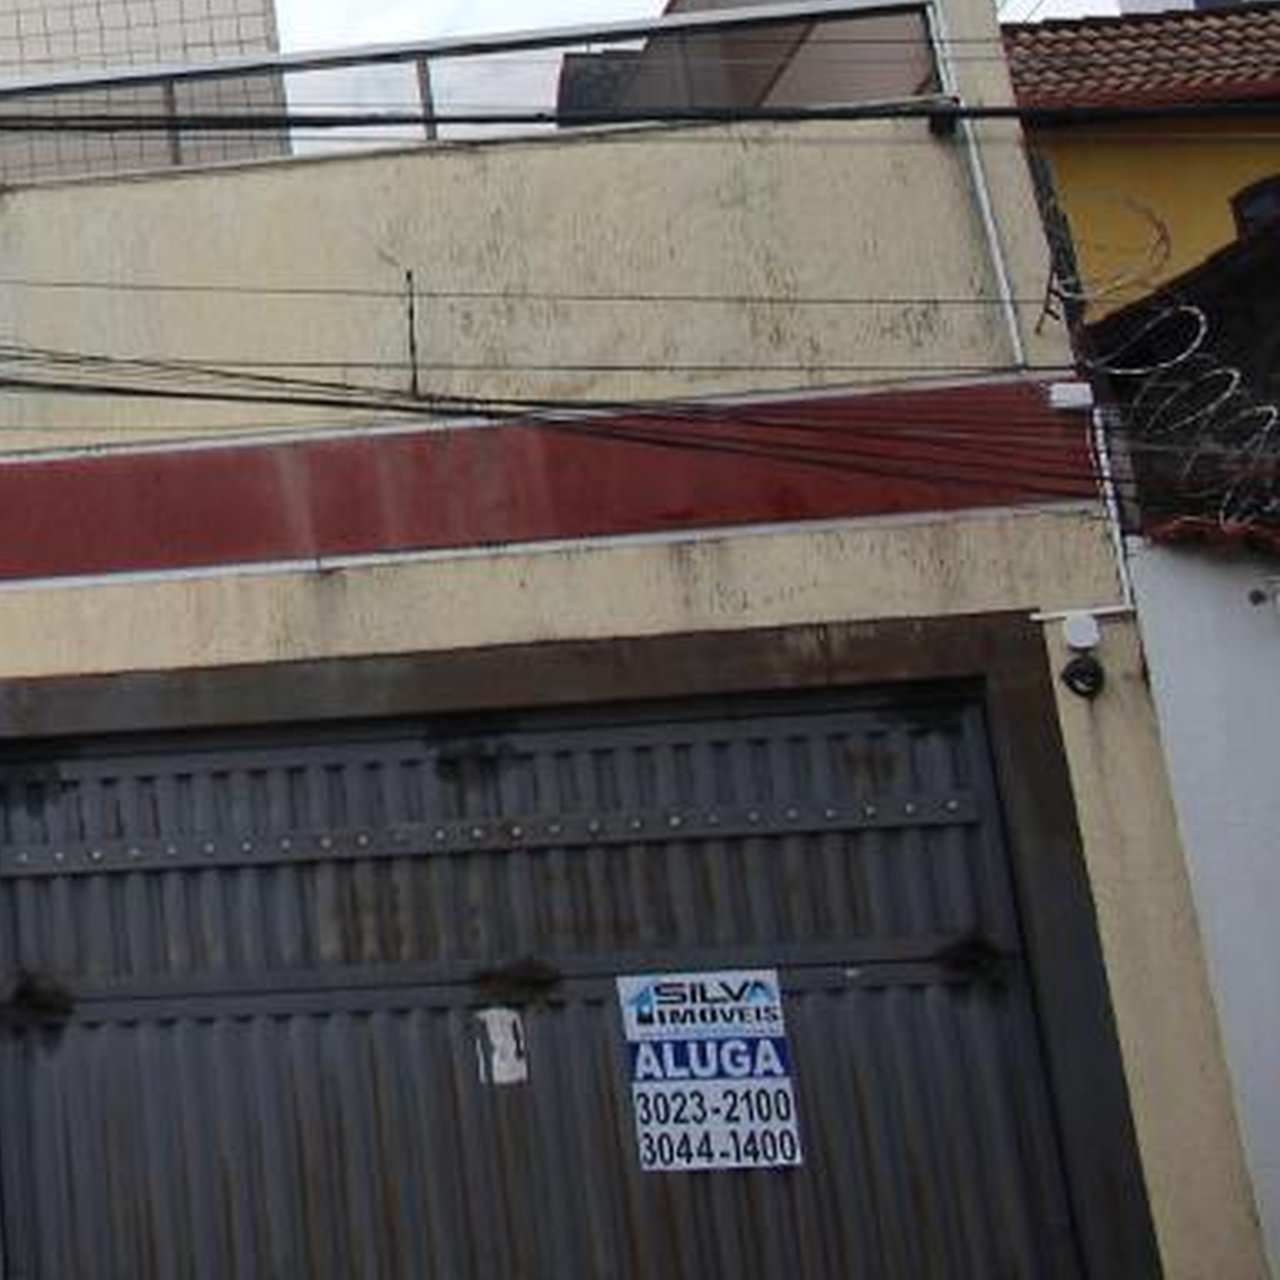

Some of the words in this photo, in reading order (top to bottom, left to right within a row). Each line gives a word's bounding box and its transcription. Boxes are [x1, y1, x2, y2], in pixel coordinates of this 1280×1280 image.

[636, 1040, 785, 1079] ALUGA
[637, 1089, 791, 1126] 3023-2100
[642, 1129, 796, 1166] 3044-1400
